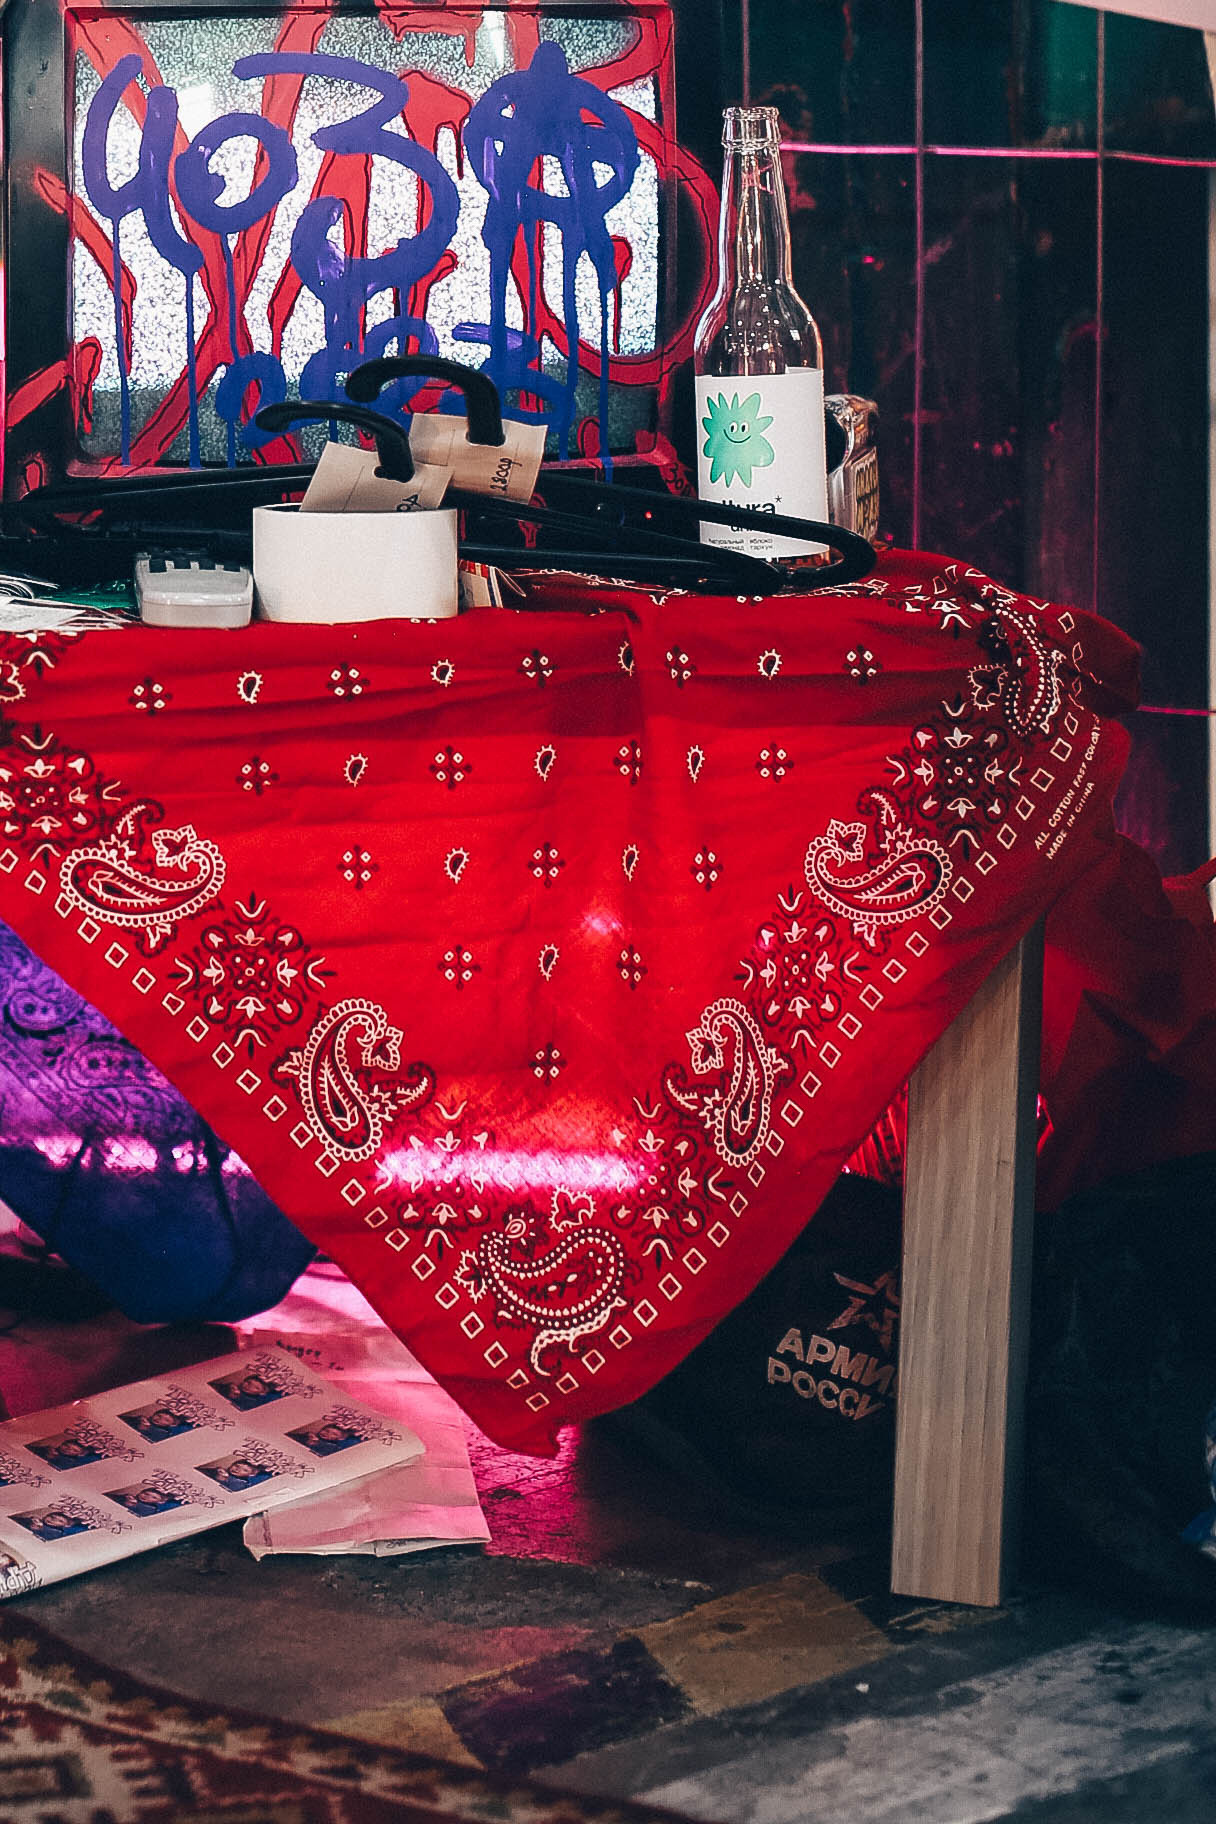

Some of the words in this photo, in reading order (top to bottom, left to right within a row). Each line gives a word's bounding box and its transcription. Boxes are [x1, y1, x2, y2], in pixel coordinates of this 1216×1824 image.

[1034, 831, 1050, 851] ALL
[1048, 789, 1075, 827] COTTON
[1073, 762, 1086, 787] FAST
[1046, 829, 1067, 859] MADE
[1067, 814, 1076, 827] IN
[1075, 782, 1094, 813] CHINA
[776, 1328, 897, 1398] АРМИ
